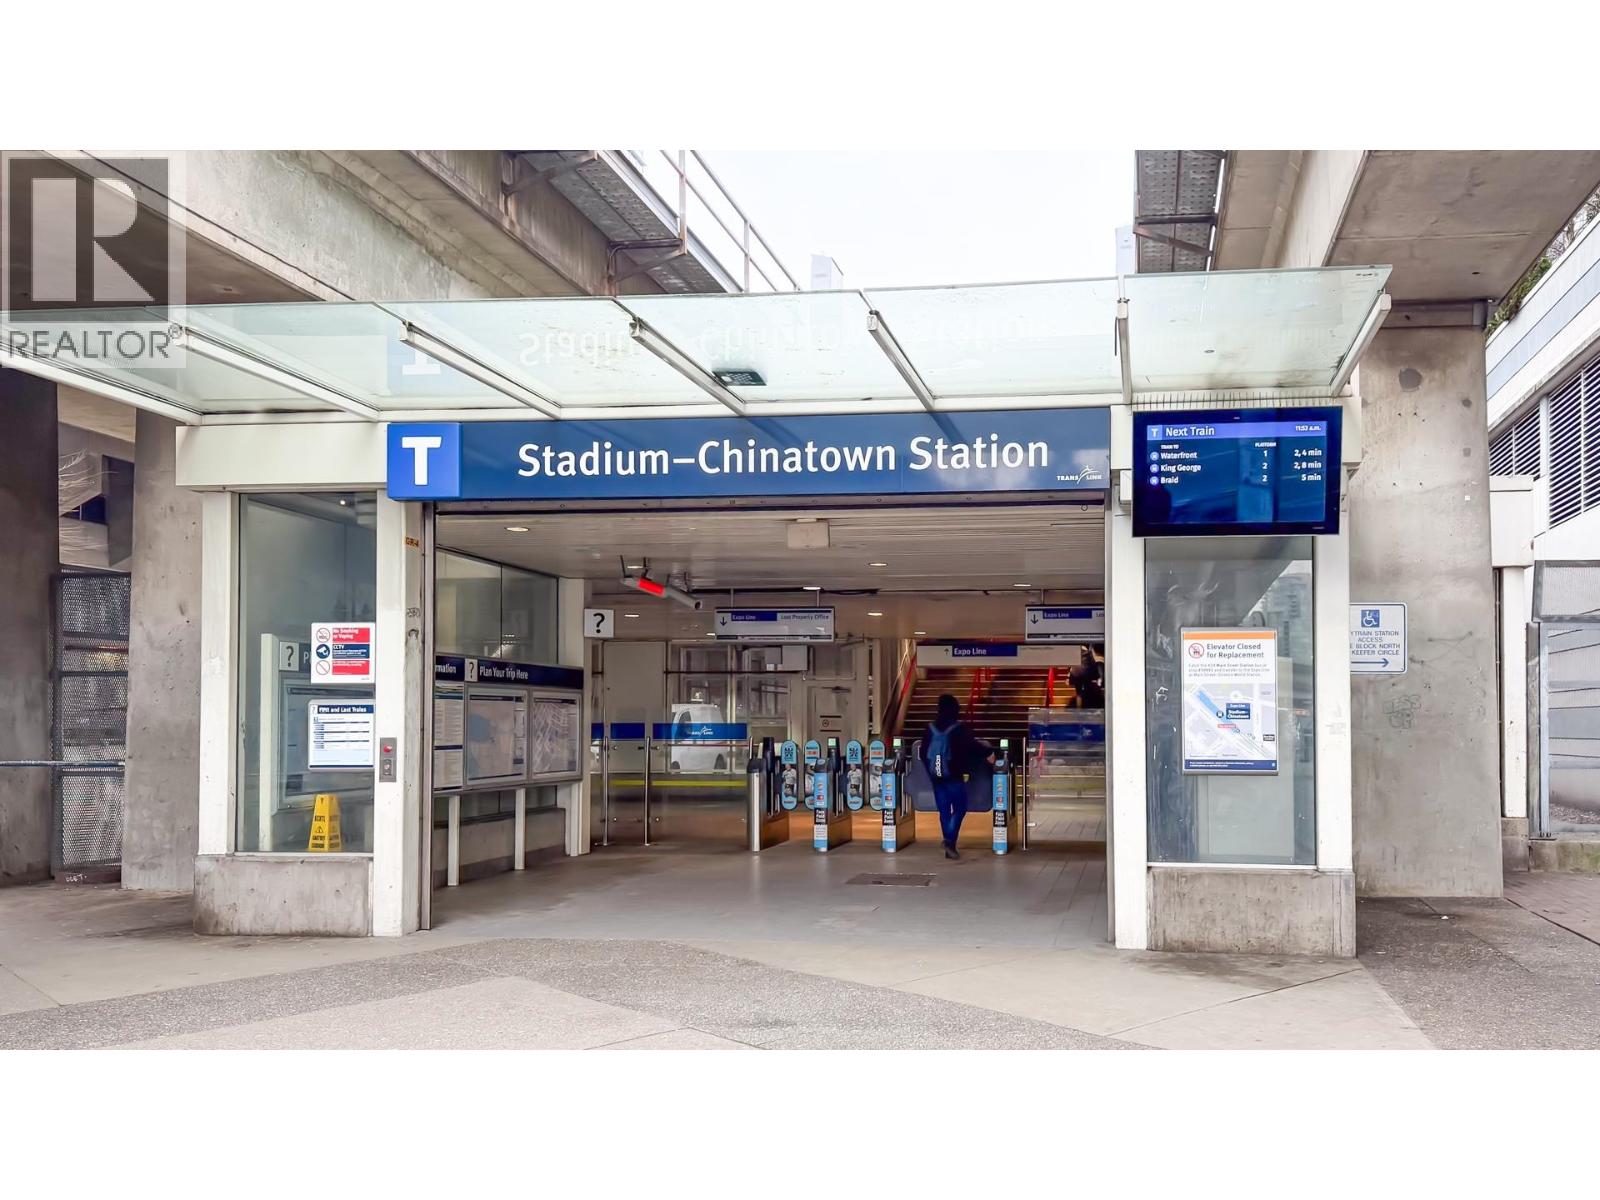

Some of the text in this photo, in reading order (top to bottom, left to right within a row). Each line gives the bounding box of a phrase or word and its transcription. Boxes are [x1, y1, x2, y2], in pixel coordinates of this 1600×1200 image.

[1165, 425, 1215, 437] Next Train
[909, 433, 1049, 470] Station
[1160, 452, 1197, 460] Waterfront
[1308, 448, 1322, 456] min
[401, 436, 443, 486] T
[1161, 464, 1202, 474] King George
[1161, 476, 1179, 484] Braid
[1307, 473, 1322, 481] min
[954, 648, 971, 657] Expo
[1218, 652, 1264, 660] Replacement
[480, 665, 529, 681] Plan Your Trip Here
[935, 754, 943, 777] adidas
